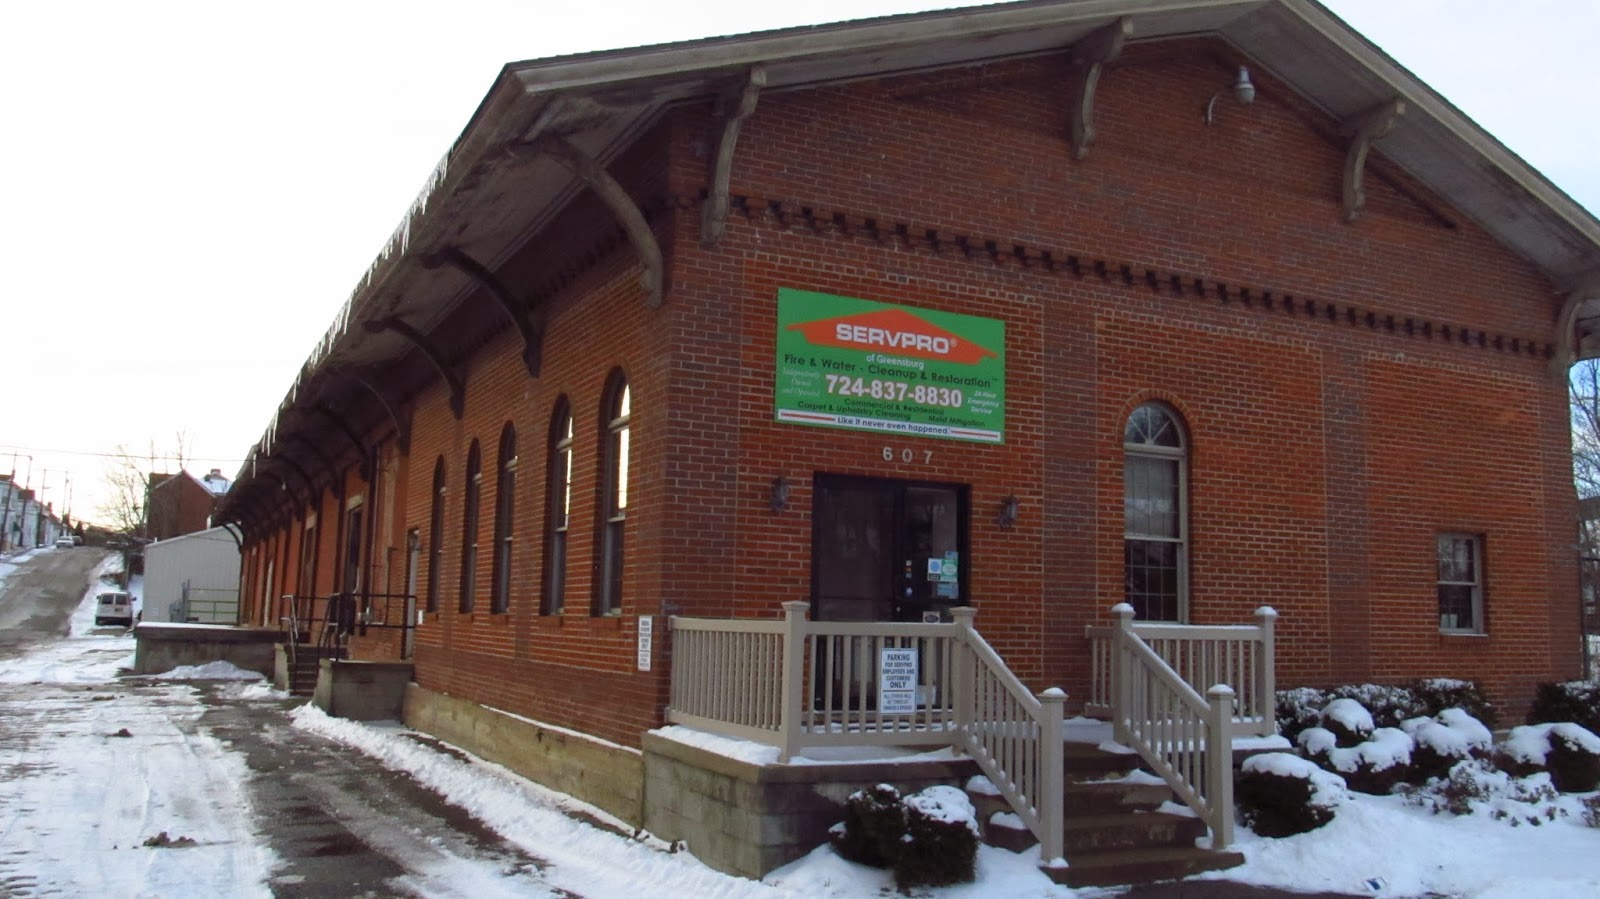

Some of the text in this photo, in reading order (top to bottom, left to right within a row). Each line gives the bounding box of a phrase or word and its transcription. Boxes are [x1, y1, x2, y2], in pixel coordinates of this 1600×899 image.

[784, 354, 805, 366] Fire
[809, 357, 817, 367] &
[821, 359, 856, 372] Water
[868, 364, 916, 380] Cleanup
[920, 372, 927, 381] &
[866, 354, 924, 370] of Greensburg
[825, 374, 962, 408] 724-837-8830
[797, 401, 826, 411] Carpet
[874, 410, 911, 421] Cleaning
[844, 398, 894, 411] Commercial
[903, 406, 945, 416] Residential
[837, 417, 853, 425] Like
[908, 424, 950, 435] happened.
[949, 417, 986, 428] Mitigation
[883, 447, 933, 464] 607
